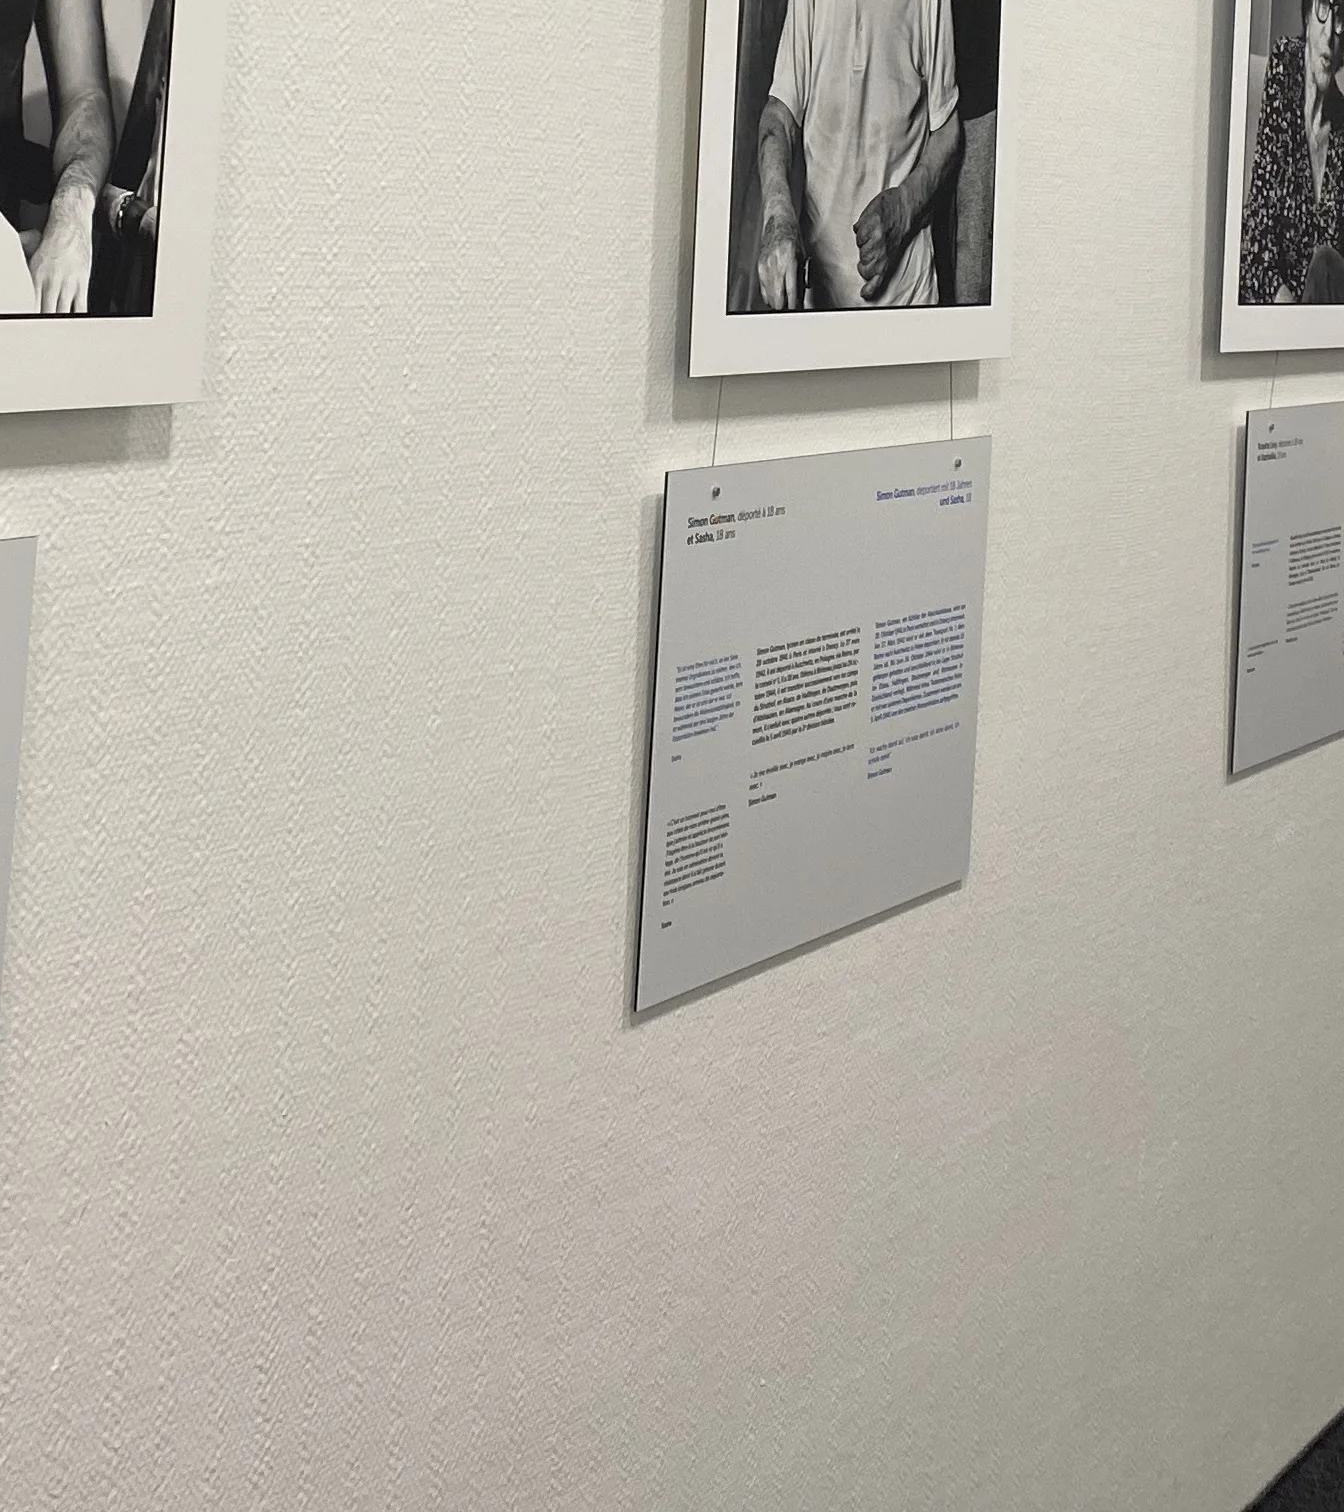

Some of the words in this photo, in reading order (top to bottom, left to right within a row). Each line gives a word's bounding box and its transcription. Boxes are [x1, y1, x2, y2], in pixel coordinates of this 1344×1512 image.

[687, 517, 709, 529] Simon
[709, 513, 736, 526] Gutman,
[737, 508, 761, 523] déporté
[775, 506, 786, 516] ans
[686, 535, 694, 546] et
[694, 532, 715, 544] Sasha,
[724, 529, 736, 540] ans
